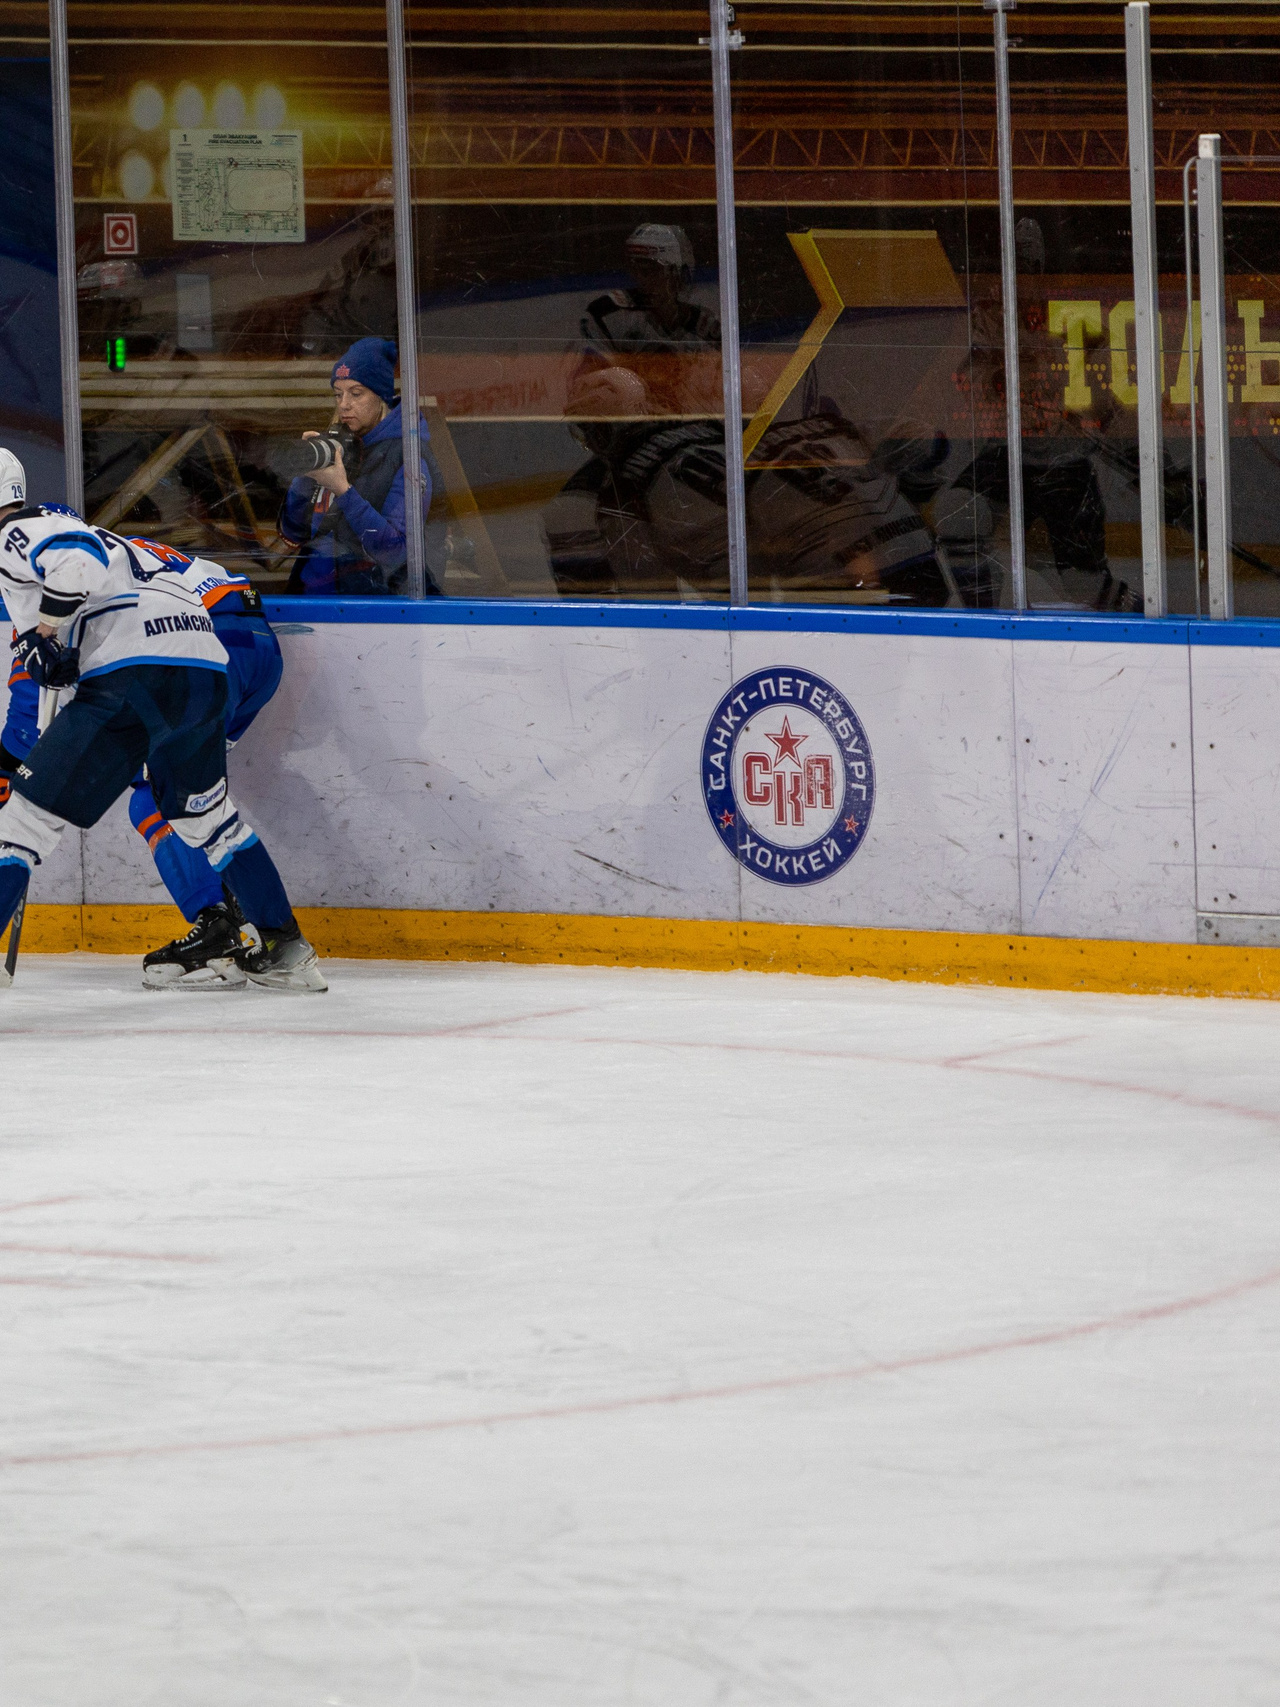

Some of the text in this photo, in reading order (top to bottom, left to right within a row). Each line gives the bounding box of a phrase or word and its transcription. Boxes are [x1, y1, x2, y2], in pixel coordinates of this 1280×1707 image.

[11, 485, 24, 499] 29
[4, 526, 30, 562] 29
[709, 676, 867, 801] САНКТ-ПЕТЕРБУРГ
[742, 751, 835, 827] СКА
[738, 834, 843, 876] ХОККЕЙ
